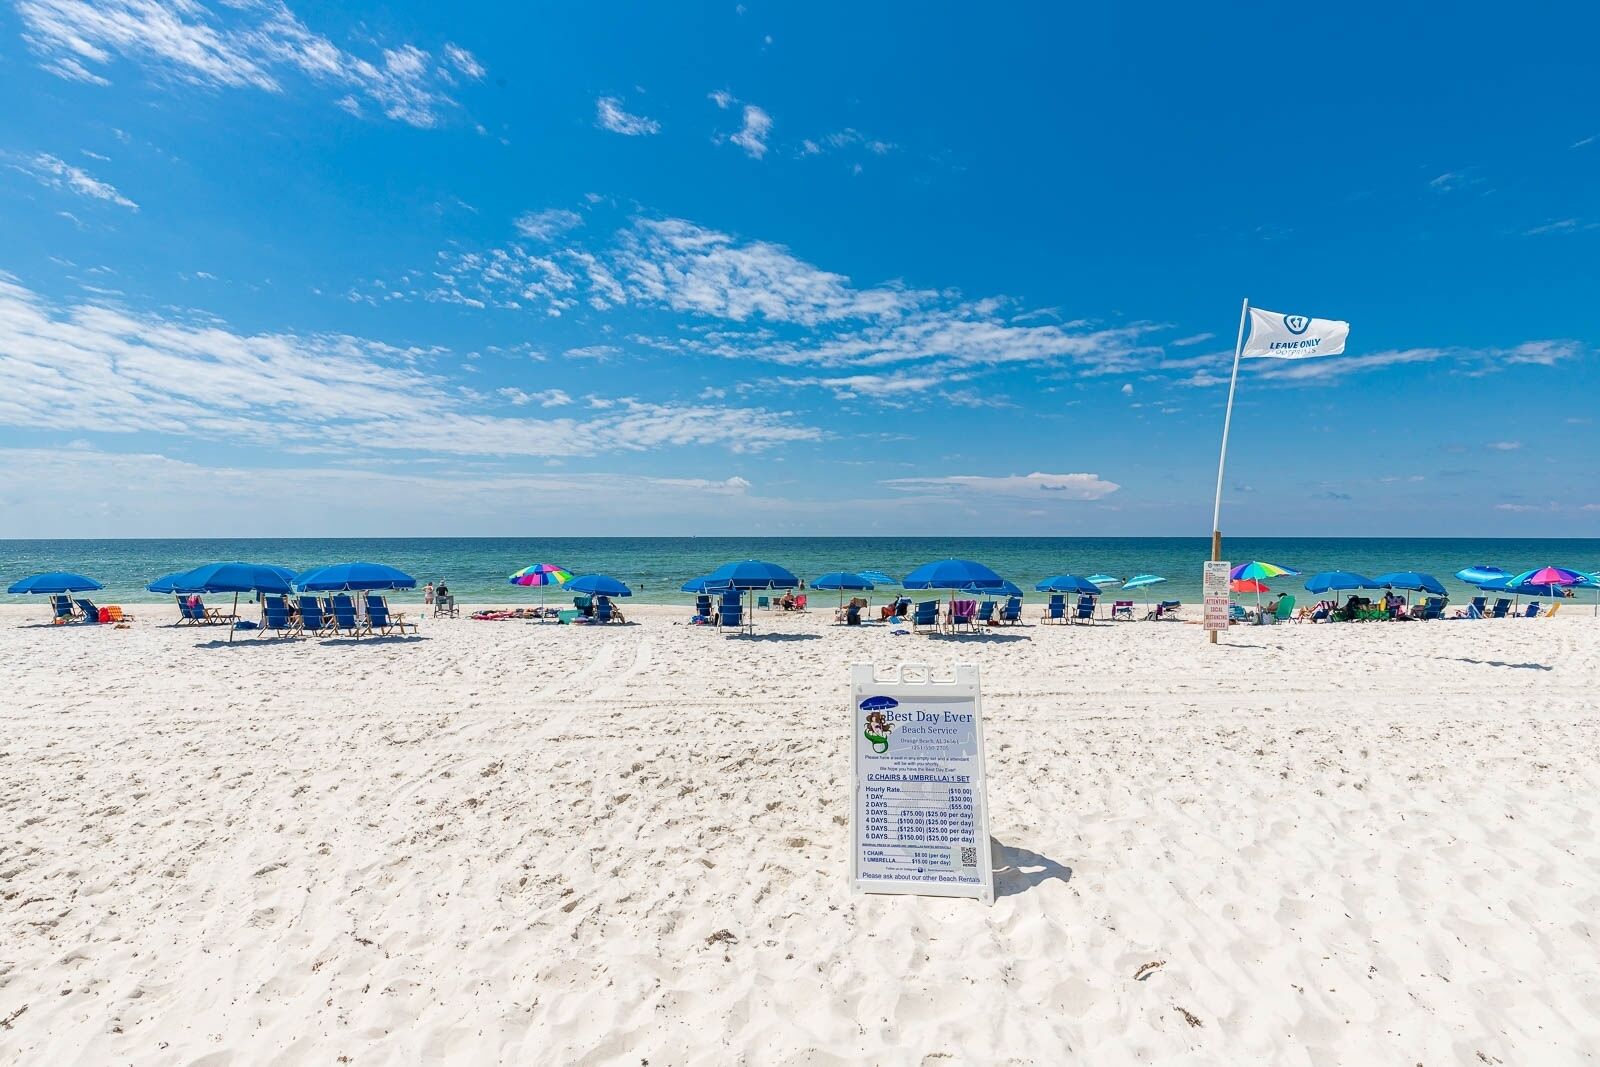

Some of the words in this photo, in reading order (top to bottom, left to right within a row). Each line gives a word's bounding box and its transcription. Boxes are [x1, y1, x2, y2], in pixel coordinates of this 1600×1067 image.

[1300, 338, 1321, 348] ONLY
[886, 710, 912, 722] Best
[916, 710, 940, 725] Day
[944, 711, 972, 722] Ever
